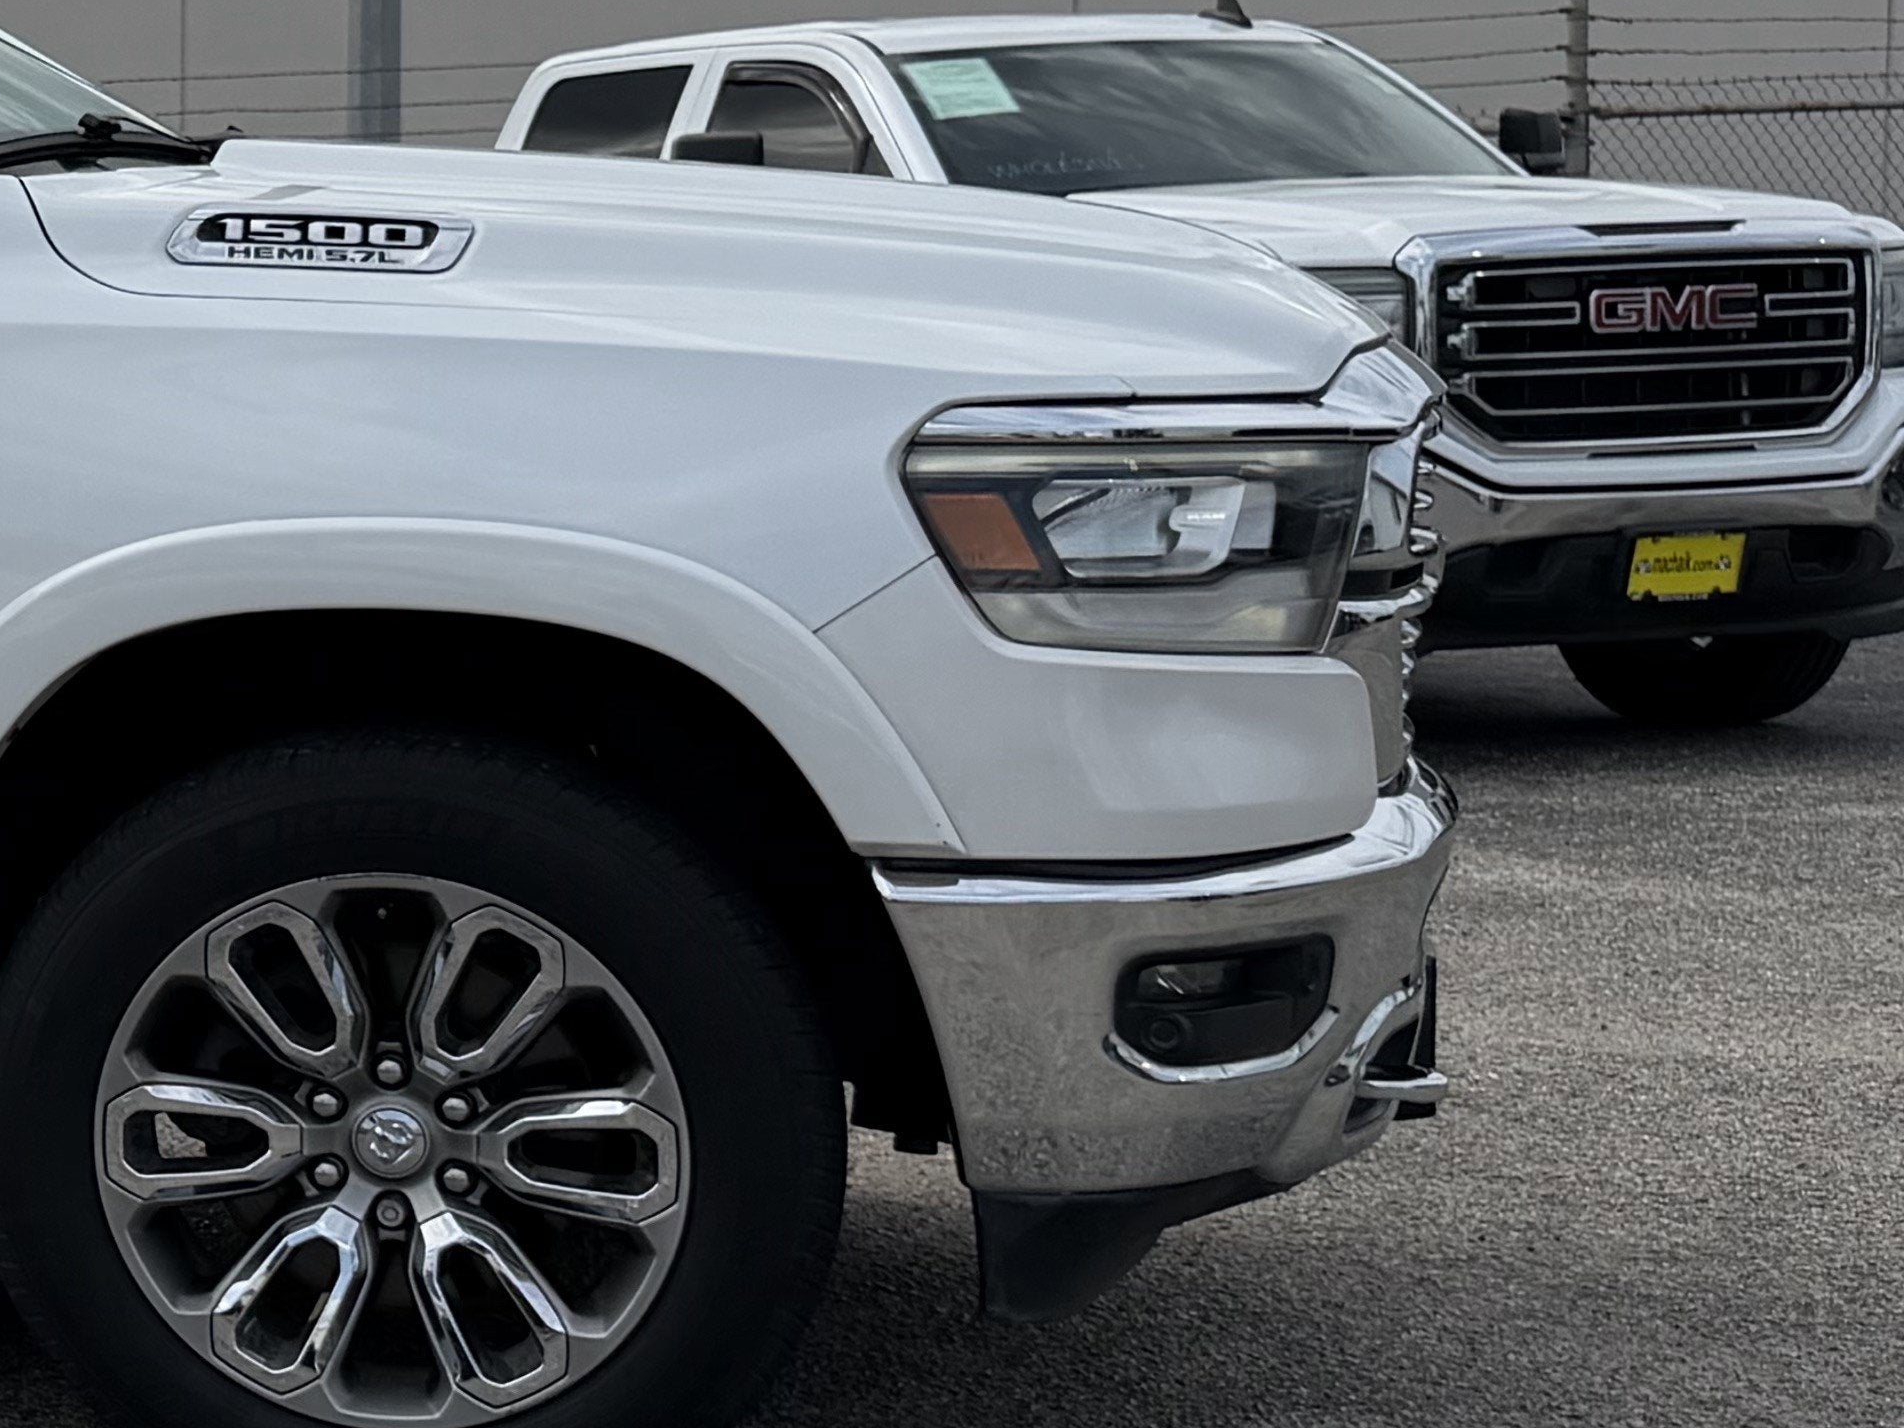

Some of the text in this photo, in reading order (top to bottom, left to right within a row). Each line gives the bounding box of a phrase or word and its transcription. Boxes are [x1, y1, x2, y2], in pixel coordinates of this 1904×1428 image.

[213, 218, 423, 246] 1500
[227, 246, 401, 264] HEMI 5.7L
[1589, 283, 1758, 333] GMC
